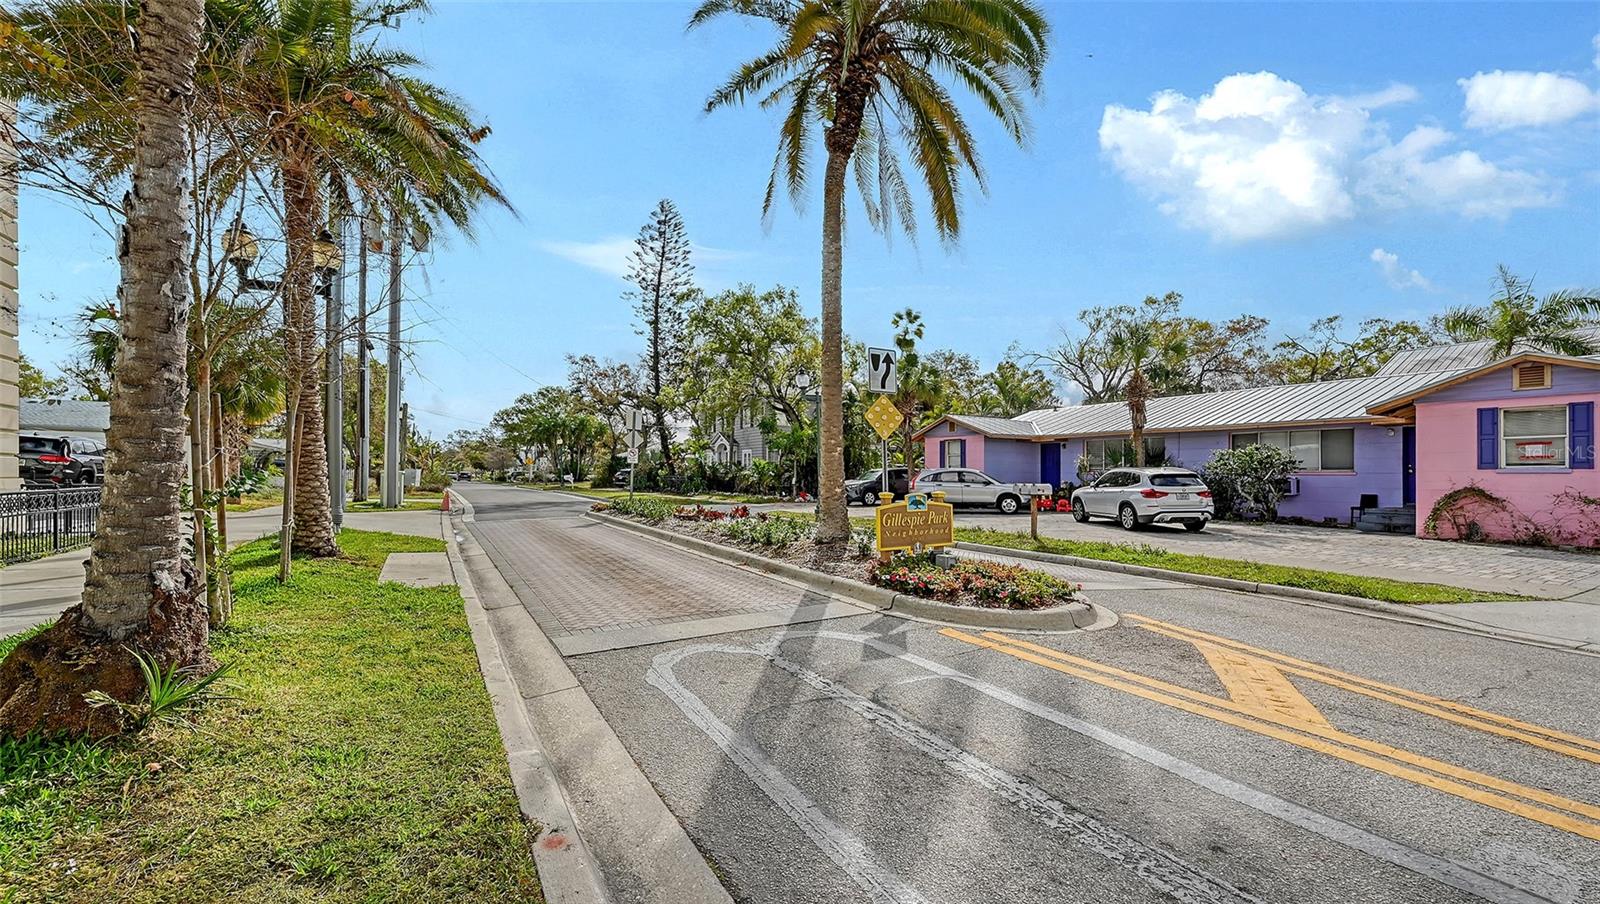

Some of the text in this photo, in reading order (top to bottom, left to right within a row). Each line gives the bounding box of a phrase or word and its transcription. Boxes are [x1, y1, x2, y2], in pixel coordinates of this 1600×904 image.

[882, 511, 949, 529] Gillespie Park
[885, 527, 950, 538] Neighborhood
